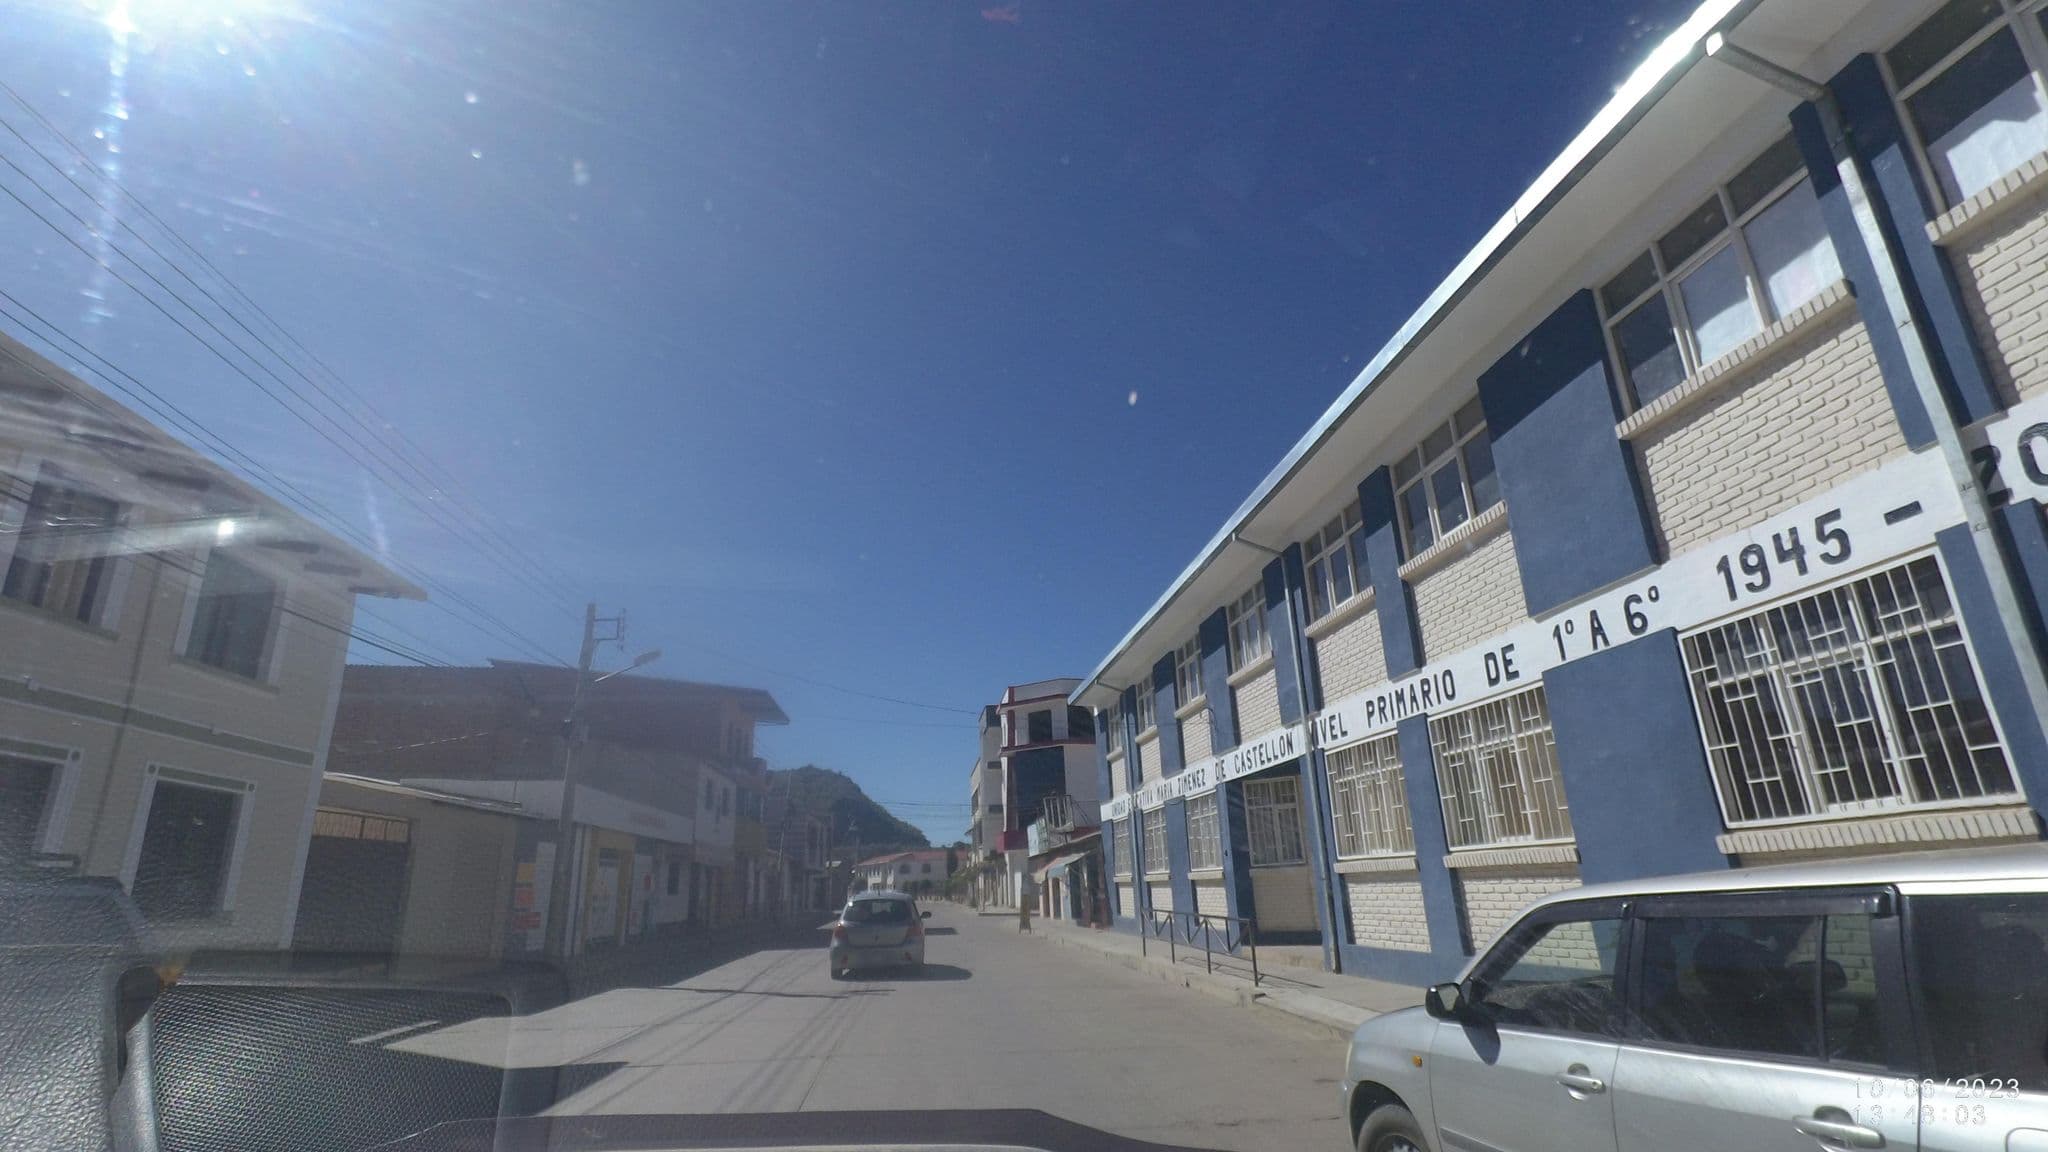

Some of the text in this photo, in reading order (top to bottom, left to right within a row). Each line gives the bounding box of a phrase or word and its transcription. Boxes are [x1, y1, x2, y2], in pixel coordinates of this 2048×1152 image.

[1178, 768, 1206, 795] JIMENEZ
[1215, 759, 1227, 779] DE
[1234, 731, 1294, 774] CASTELLON
[1365, 668, 1457, 729] PRIMARIO
[1484, 643, 1520, 687] DE
[1589, 609, 1611, 652] A
[1715, 507, 1852, 601] 1945
[1883, 500, 1924, 525] -
